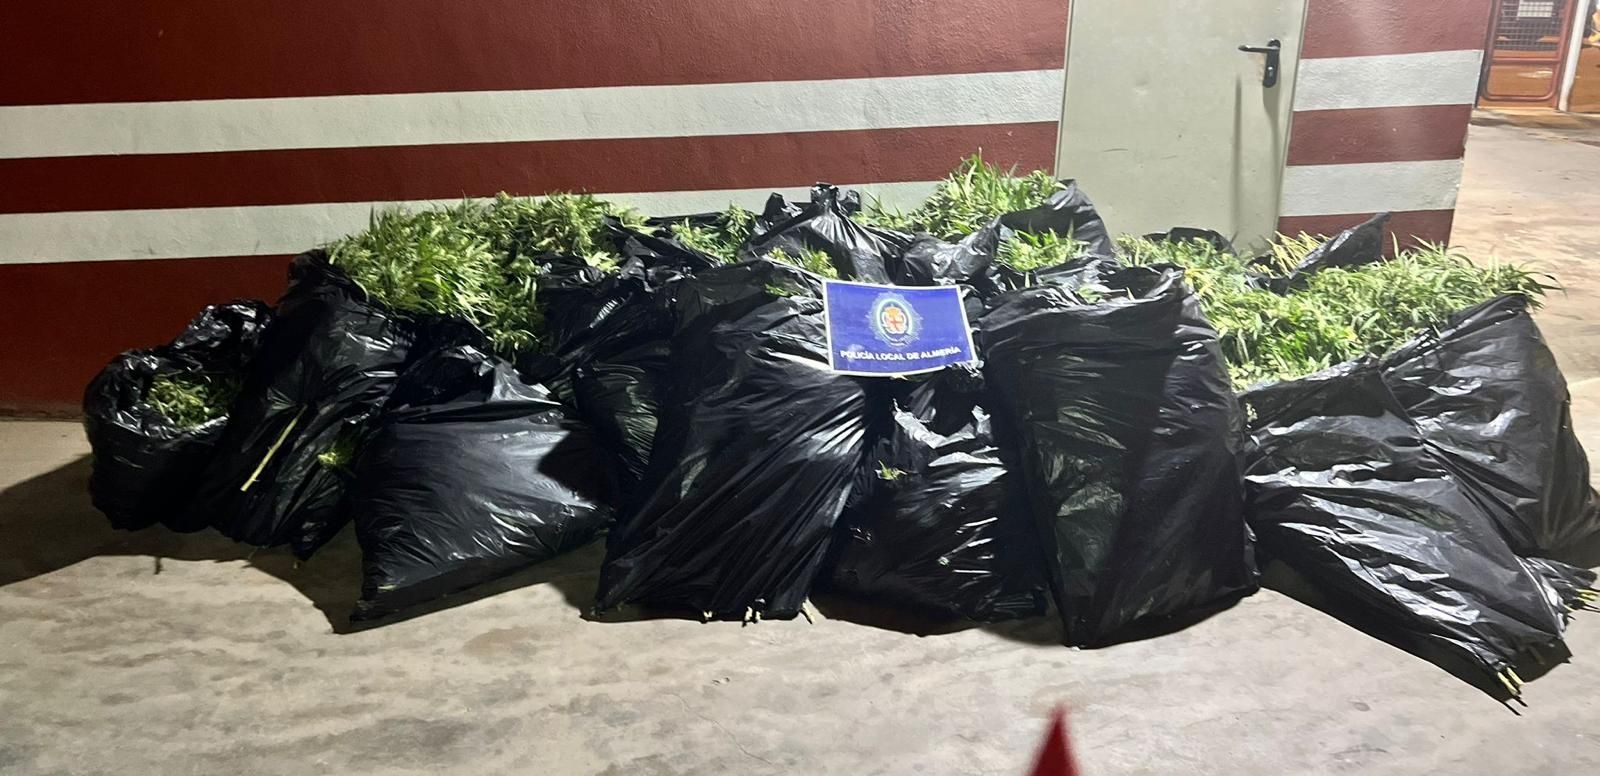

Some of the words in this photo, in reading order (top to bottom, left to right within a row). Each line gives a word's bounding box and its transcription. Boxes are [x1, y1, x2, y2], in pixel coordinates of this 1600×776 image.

[840, 350, 874, 360] POLICÍA
[875, 352, 907, 361] LOCAL
[907, 352, 920, 360] DE
[921, 346, 962, 359] ALMERÍA
